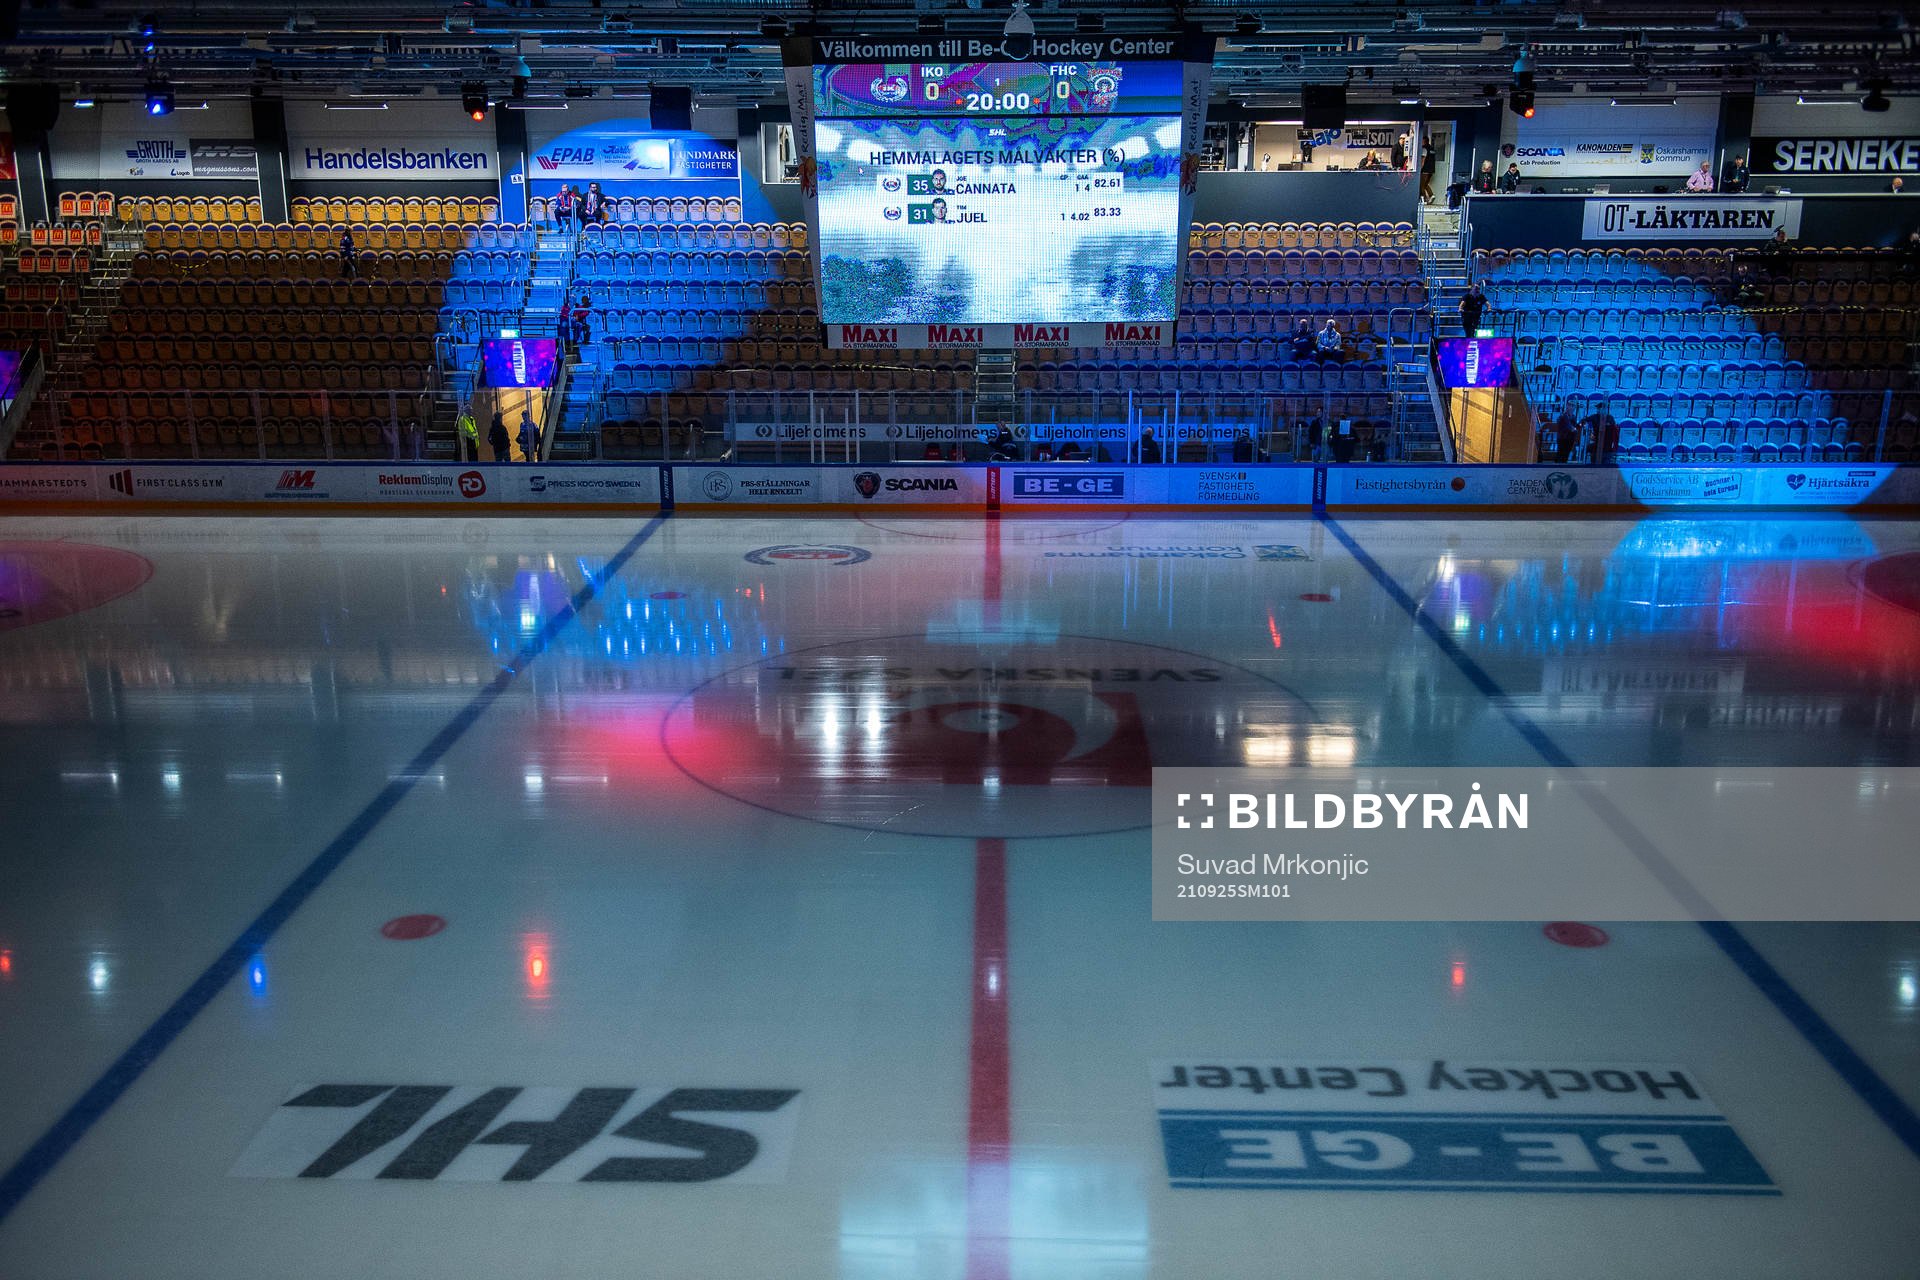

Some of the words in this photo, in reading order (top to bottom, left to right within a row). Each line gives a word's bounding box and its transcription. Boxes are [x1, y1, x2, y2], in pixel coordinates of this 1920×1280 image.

[819, 40, 933, 58] Välkommen
[938, 39, 962, 58] till
[1032, 38, 1104, 60] Hockey
[1109, 37, 1174, 56] Center
[921, 66, 944, 77] IKO
[1050, 65, 1077, 76] FHC
[995, 78, 1000, 86] 1
[925, 82, 940, 101] 0
[1056, 80, 1070, 99] 0
[1190, 79, 1199, 107] Mat
[795, 83, 805, 111] Mat
[966, 93, 1030, 111] 20:00
[799, 115, 809, 153] Redig
[988, 128, 1007, 136] SHL
[1188, 112, 1200, 150] Redig
[136, 140, 174, 159] GROTH
[1516, 148, 1566, 157] SCANIA
[1576, 143, 1623, 151] KANONADEN
[1656, 146, 1708, 155] Oskarshamns
[305, 147, 488, 170] Handelsbanken
[550, 147, 595, 162] EPAB
[672, 150, 737, 160] LUNDMARK
[869, 150, 994, 166] HEMMALAGETS
[998, 146, 1097, 165] MÅLVAKTER
[1102, 147, 1125, 167] (%)
[1773, 139, 1920, 172] SERNEKE
[675, 161, 733, 170] ASTIGHETER
[912, 180, 929, 191] 35
[955, 183, 1017, 195] CANNATA
[1094, 178, 1121, 188] 82.61
[913, 208, 928, 220] 31
[955, 212, 988, 223] JUEL
[1070, 213, 1090, 221] 4.02
[1093, 207, 1121, 217] 83.33
[1604, 203, 1776, 232] OT-LÄKTAREN
[842, 325, 898, 343] MAXI
[927, 324, 983, 342] MAXI
[1013, 323, 1069, 342] MAXI
[1105, 322, 1161, 341] MAXI
[905, 425, 998, 442] Liljeholmens
[378, 474, 454, 487] ReklamDisplay
[1199, 472, 1237, 480] SVENSK
[137, 479, 165, 488] FIRST
[167, 479, 200, 488] CLASS
[202, 479, 223, 488] GYM
[547, 480, 576, 488] PRESS
[577, 480, 604, 488] KOGYO
[605, 480, 641, 488] SWEDEN
[885, 478, 958, 491] SCANIA
[1199, 482, 1254, 490] FASTIGHETS
[1355, 478, 1446, 492] Fastighetsbyrån
[1808, 477, 1870, 490] Hjärtsäkra
[1198, 491, 1260, 501] FÖRMEDLING
[1507, 487, 1552, 495] CENTRUM
[937, 666, 1223, 683] SVENSKA
[1160, 1064, 1408, 1099] Center
[1429, 1059, 1701, 1101] Hockey
[280, 1083, 803, 1183] SHL
